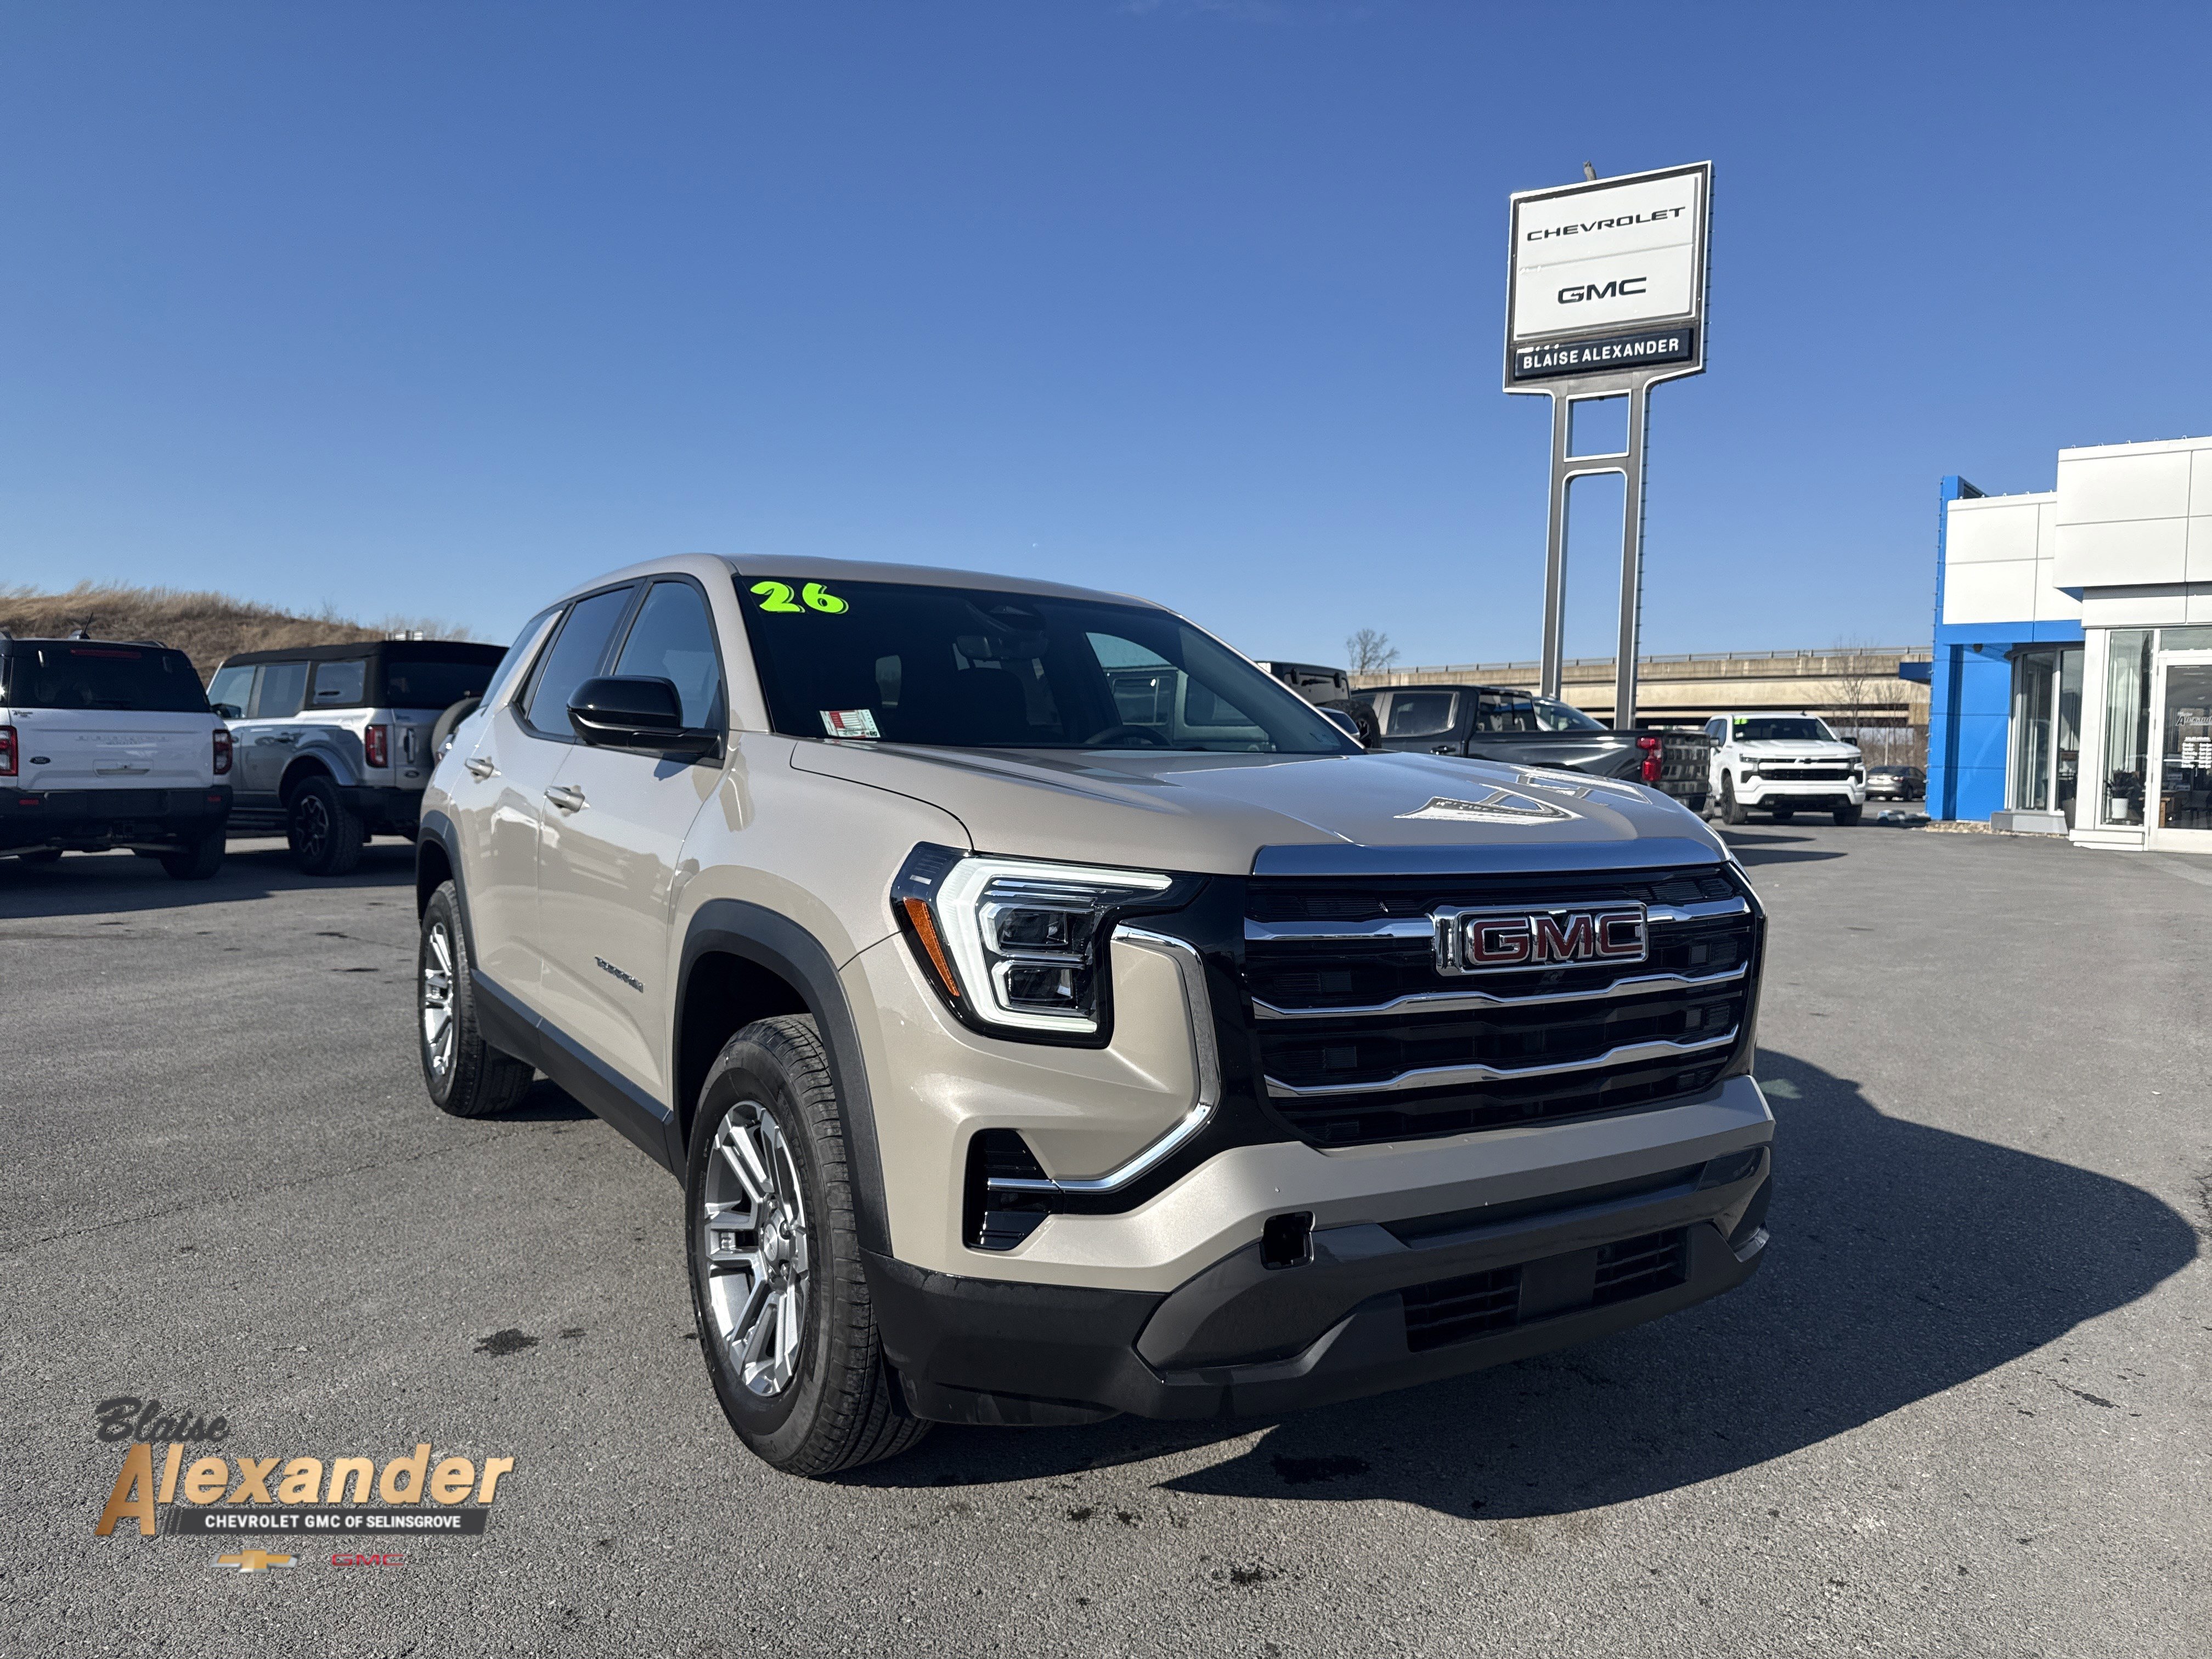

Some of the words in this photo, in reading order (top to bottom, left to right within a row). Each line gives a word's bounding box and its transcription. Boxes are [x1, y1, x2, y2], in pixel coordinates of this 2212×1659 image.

[1527, 206, 1686, 241] CHEVROLET
[1558, 276, 1647, 304] GMC
[1523, 350, 1578, 369] BLAISE
[1582, 338, 1679, 362] ALEXANDER
[750, 581, 849, 614] 26
[1466, 910, 1645, 966] GMC
